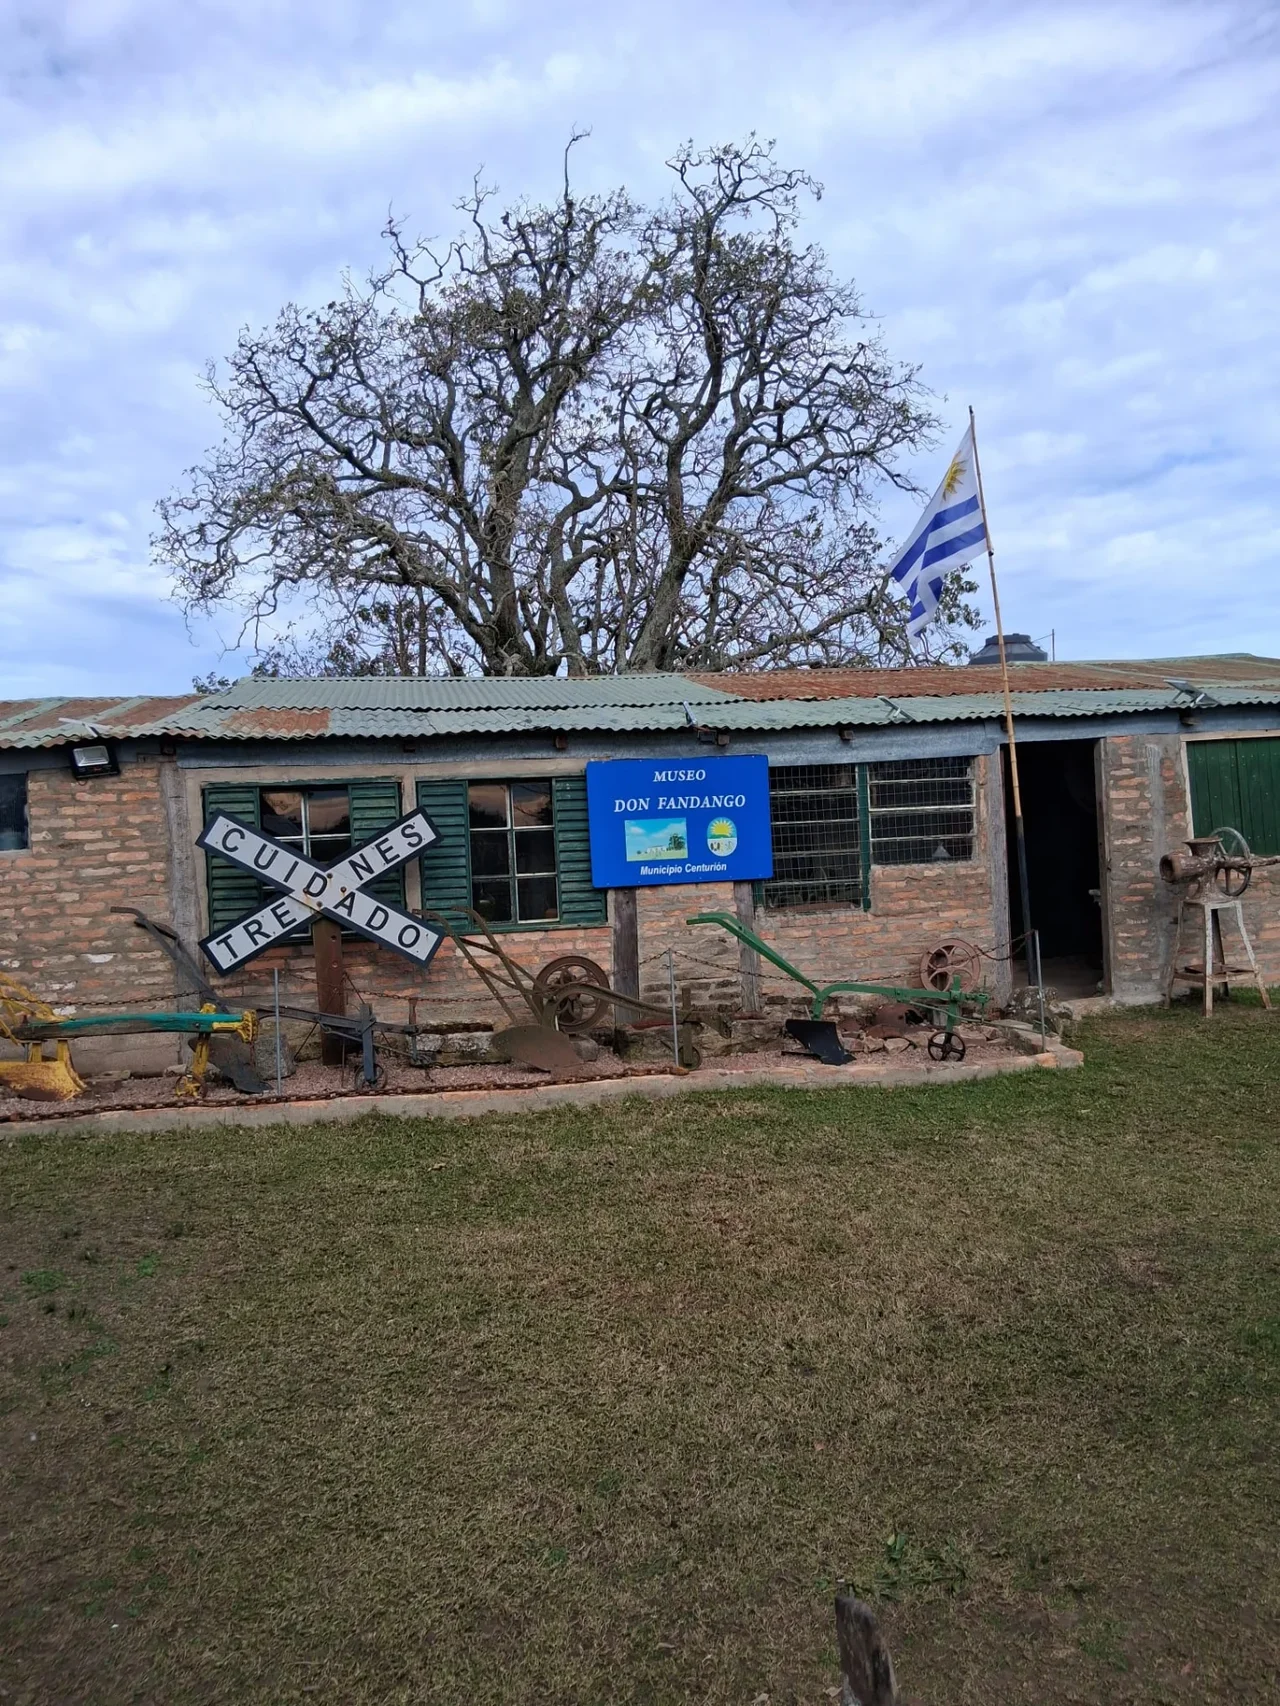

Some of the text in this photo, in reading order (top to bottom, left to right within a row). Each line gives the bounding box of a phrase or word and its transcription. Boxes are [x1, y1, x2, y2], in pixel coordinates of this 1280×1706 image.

[653, 769, 706, 782] MUSEO
[614, 794, 746, 812] DON FANDANGO
[640, 862, 727, 876] Municipio Centurión
[221, 828, 421, 949] CUIDADO
